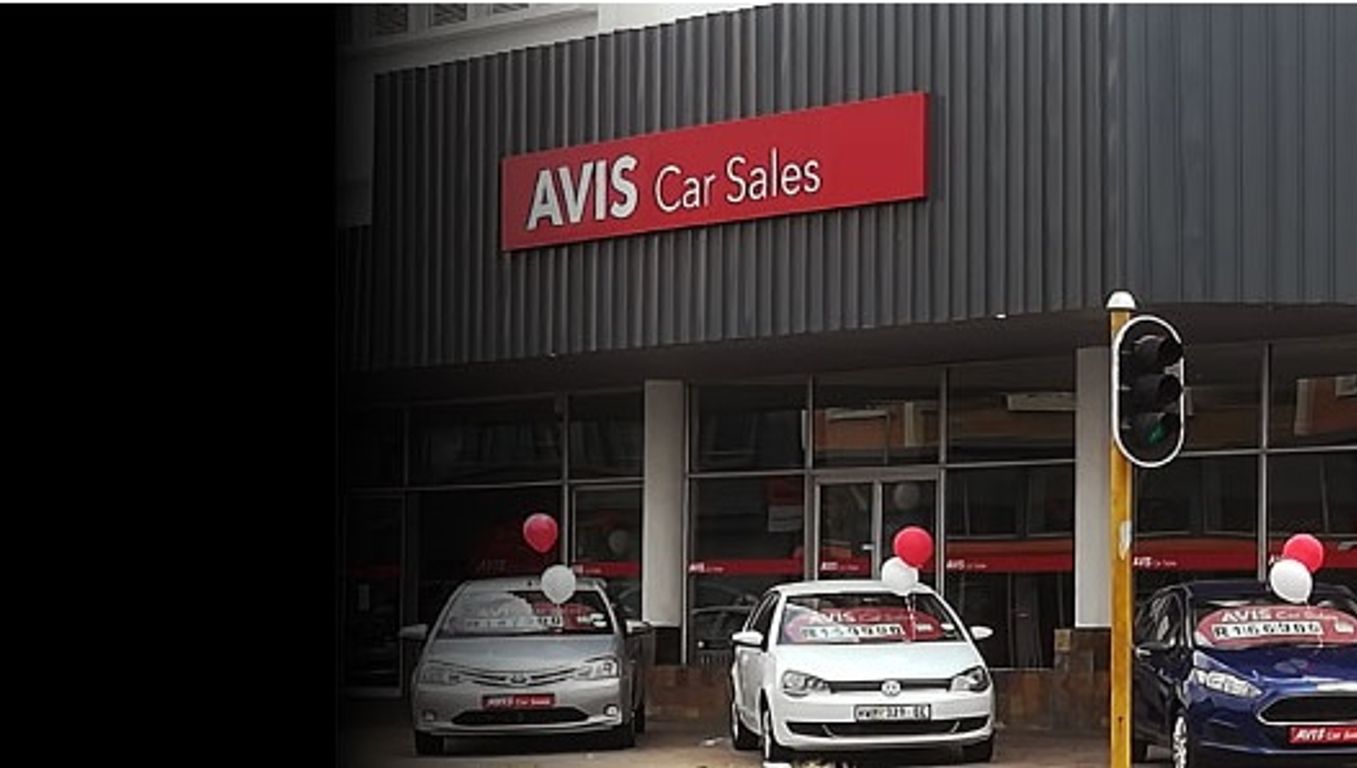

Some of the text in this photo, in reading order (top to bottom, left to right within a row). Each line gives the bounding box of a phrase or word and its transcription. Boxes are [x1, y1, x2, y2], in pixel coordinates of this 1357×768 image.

[526, 147, 821, 231] AVIS Car Sales
[1221, 610, 1271, 622] AVIS
[1297, 727, 1326, 740] AVIS
